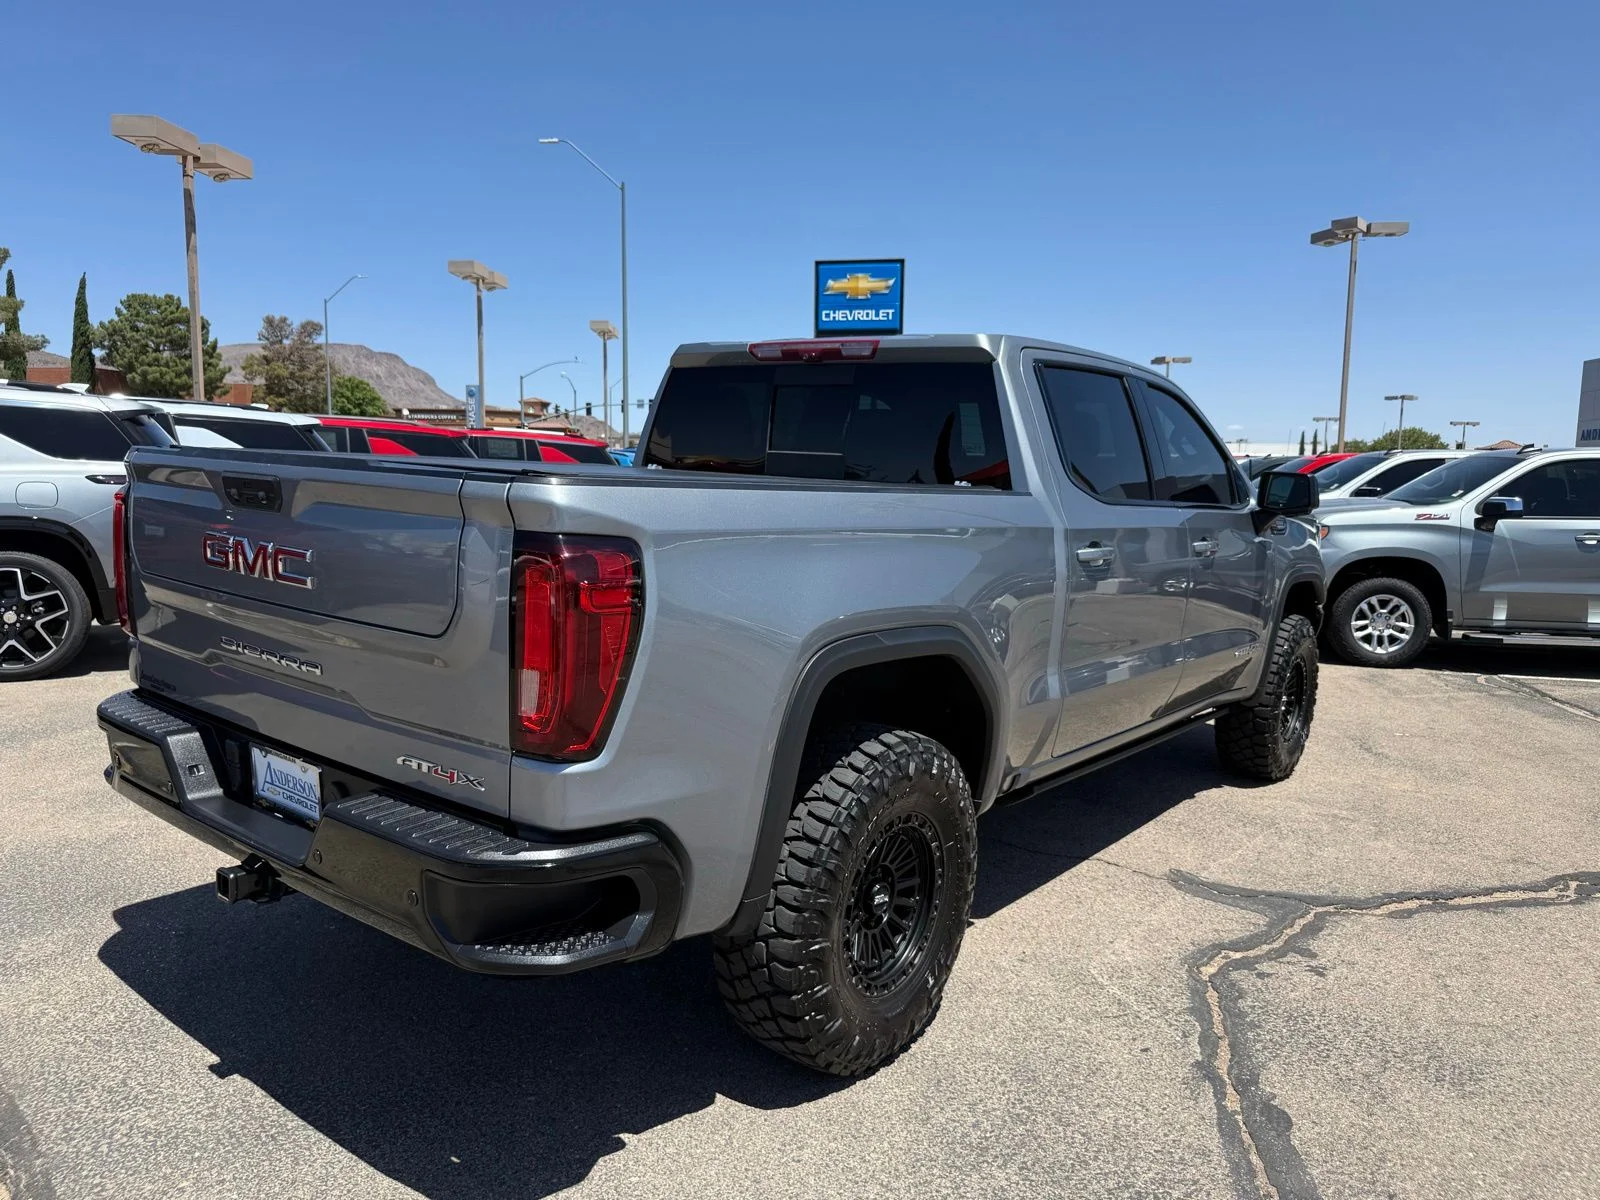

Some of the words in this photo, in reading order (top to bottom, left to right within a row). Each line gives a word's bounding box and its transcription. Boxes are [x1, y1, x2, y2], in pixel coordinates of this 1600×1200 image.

[822, 309, 895, 321] CHEVROLET
[203, 531, 313, 589] GMC
[220, 636, 323, 675] SIERRA
[261, 761, 318, 800] ANDERSON
[397, 756, 485, 791] AT4X
[282, 791, 318, 813] CHEVROLET
